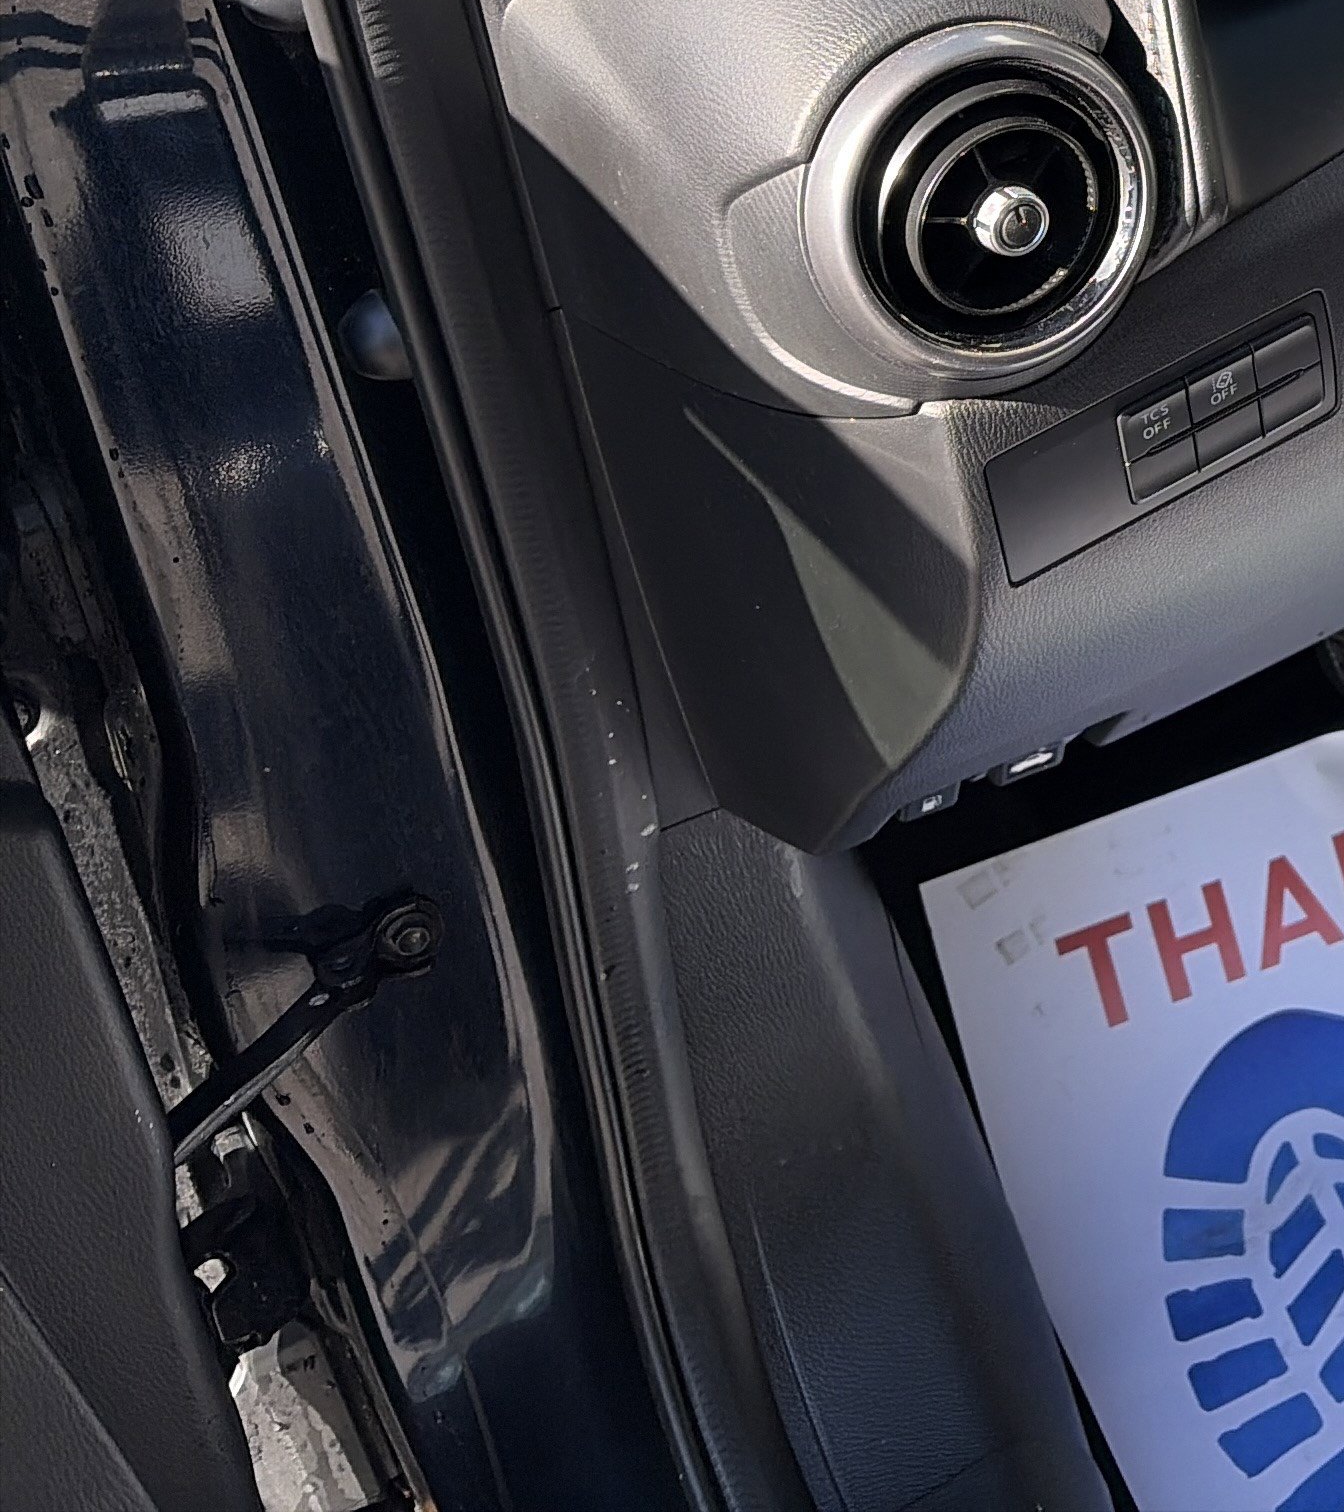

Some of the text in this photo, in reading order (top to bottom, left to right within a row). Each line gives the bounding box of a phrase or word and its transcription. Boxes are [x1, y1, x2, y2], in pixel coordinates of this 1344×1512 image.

[1210, 383, 1238, 406] OFF
[1140, 404, 1169, 426] TCS
[1143, 418, 1171, 440] OFF
